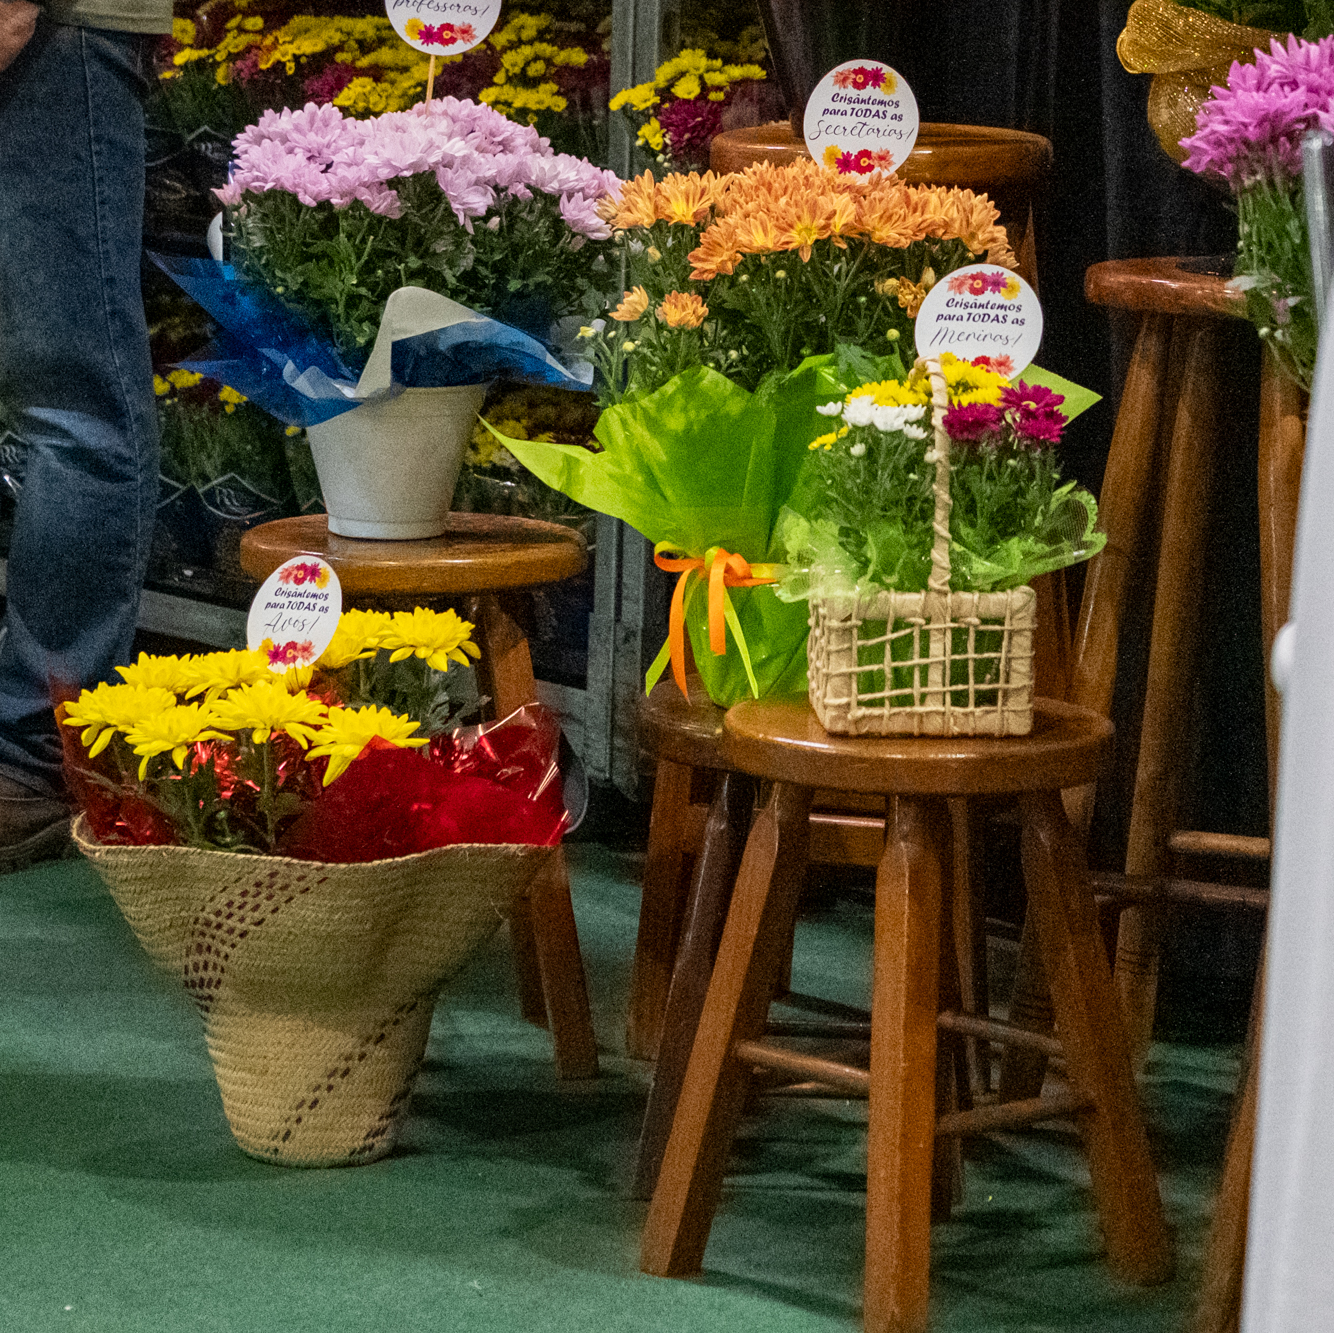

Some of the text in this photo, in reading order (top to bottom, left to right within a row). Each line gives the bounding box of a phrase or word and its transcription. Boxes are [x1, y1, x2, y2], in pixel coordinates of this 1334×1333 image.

[831, 92, 900, 109] Crisântemos
[822, 107, 903, 122] para TODAS as
[809, 119, 915, 142] Secretárias!
[946, 297, 1022, 313] Crisântemos
[936, 312, 1026, 326] para TODAS as
[929, 326, 1023, 348] Meninas!
[275, 587, 329, 601] Crisântemos
[264, 601, 329, 614] para TODAS as
